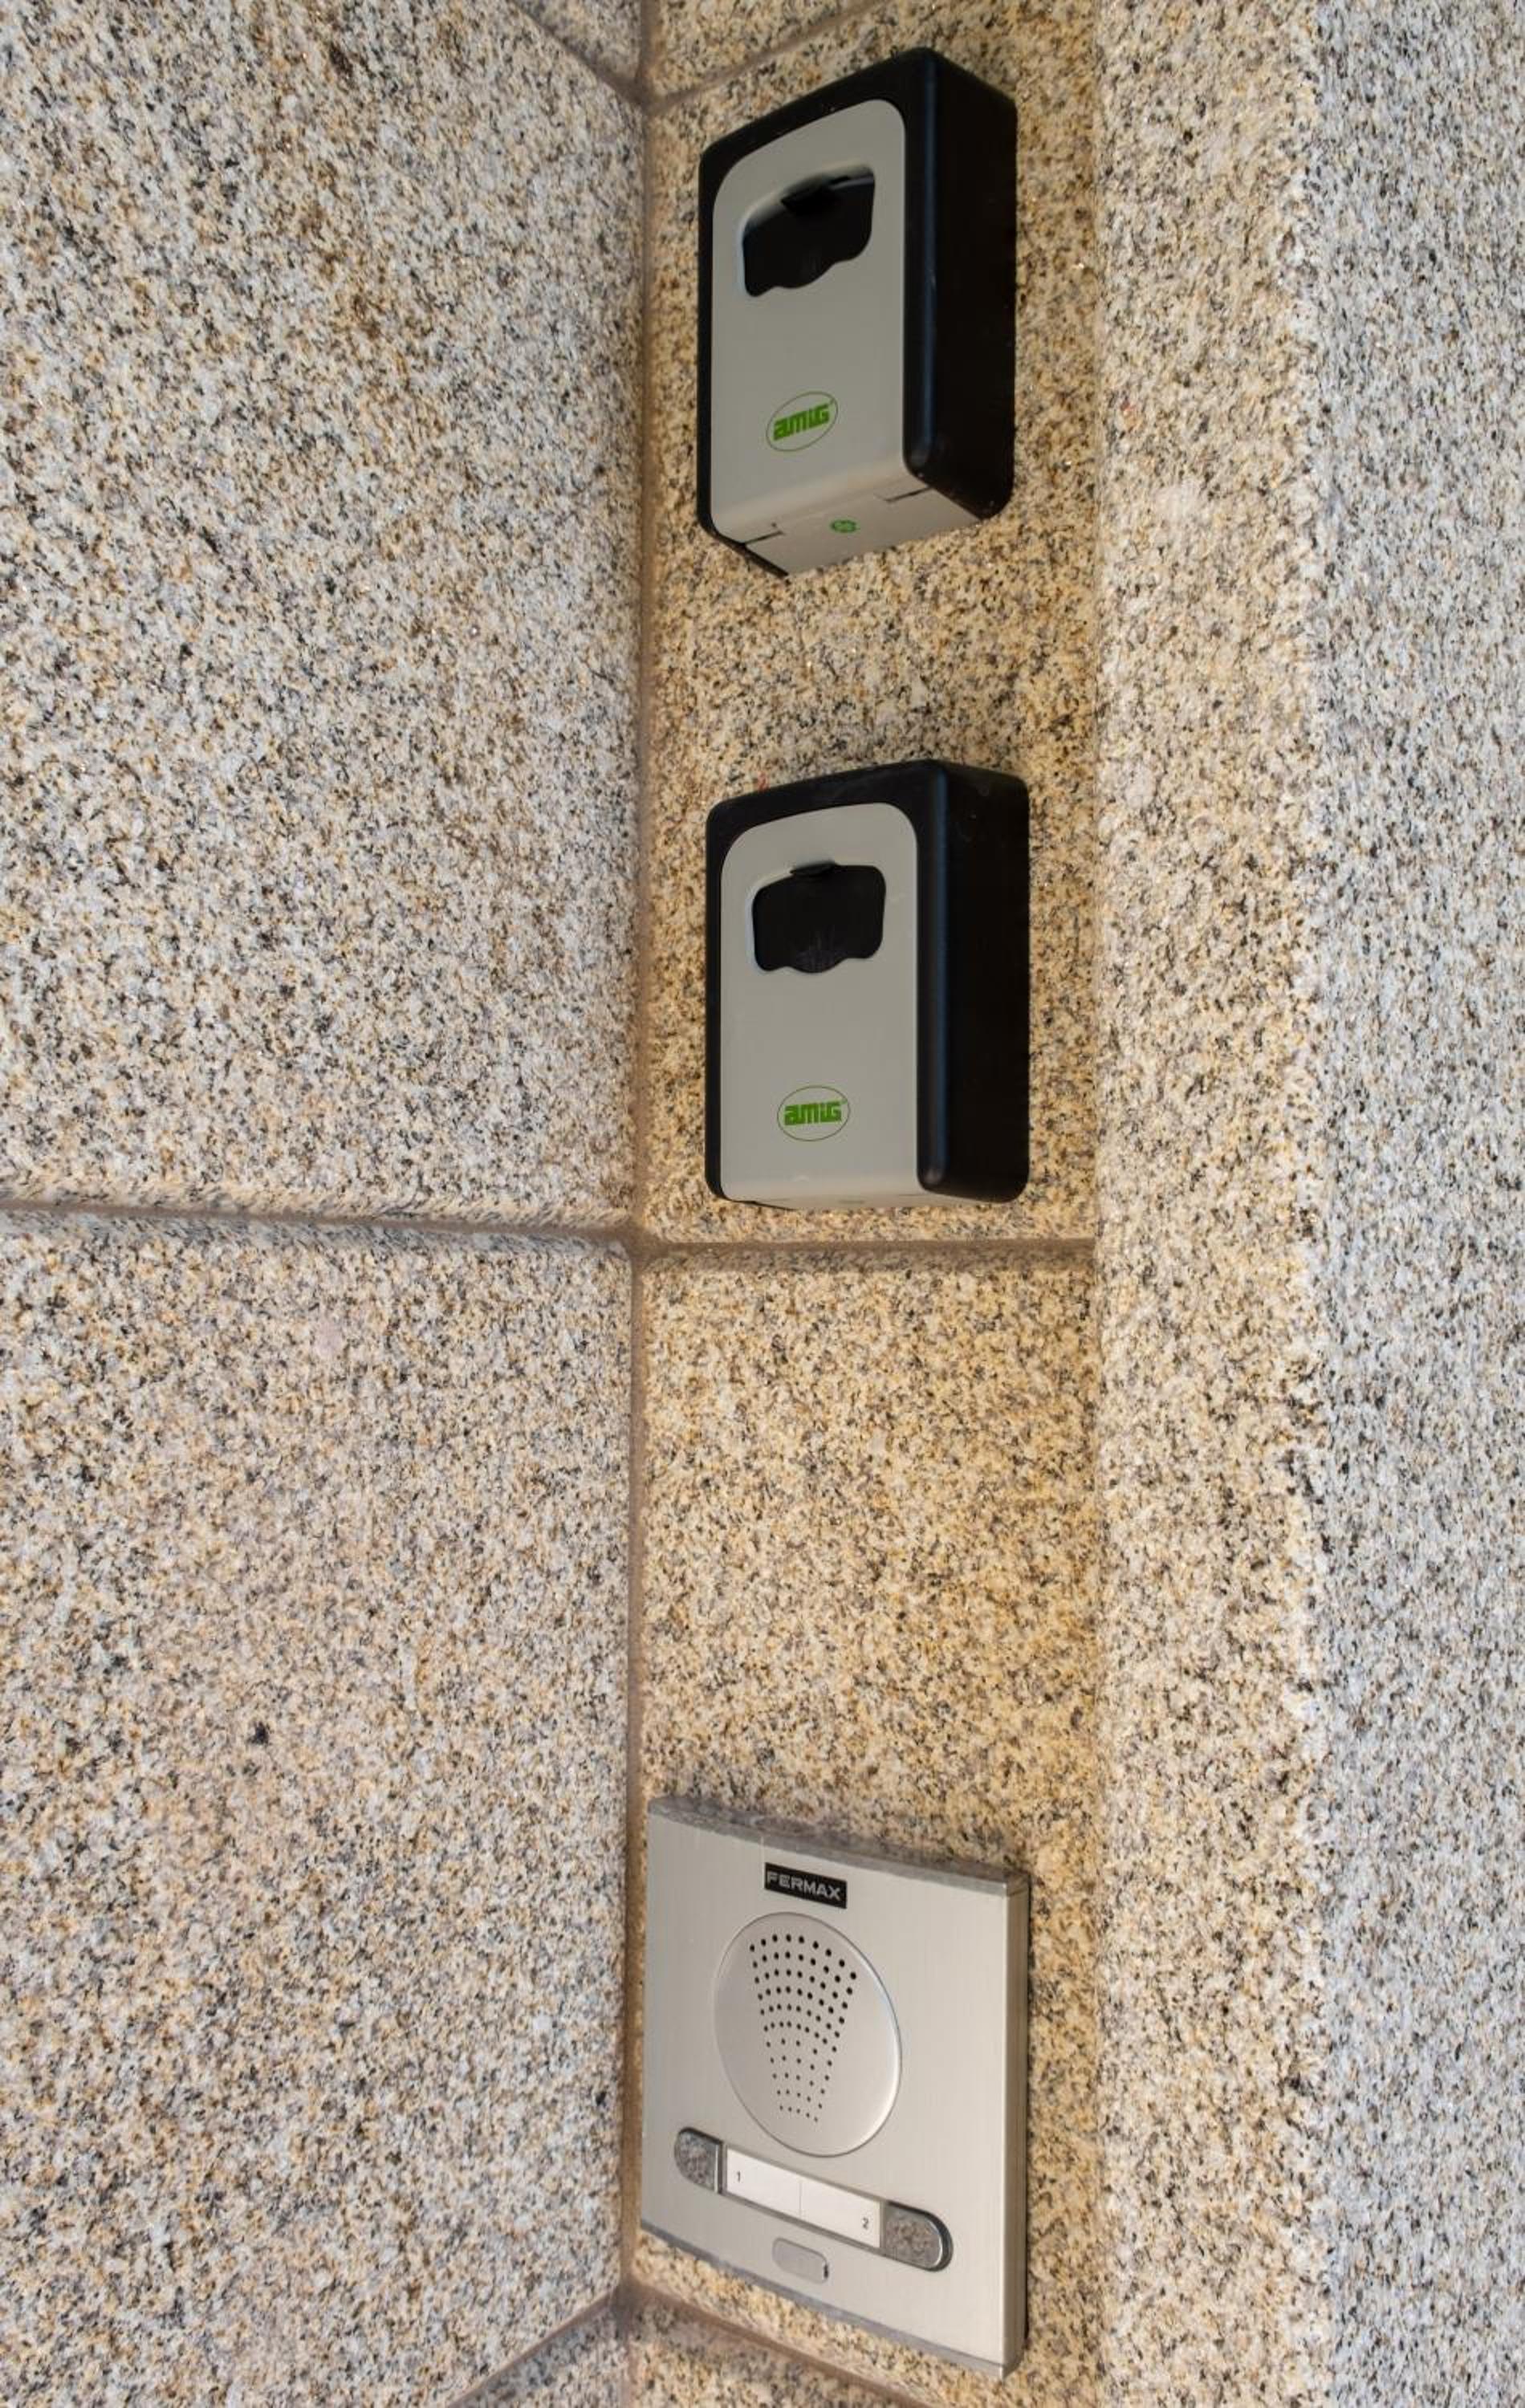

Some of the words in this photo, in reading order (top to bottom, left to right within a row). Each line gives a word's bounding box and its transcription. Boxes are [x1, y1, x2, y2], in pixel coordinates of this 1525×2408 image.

[767, 1871, 840, 1901] FERMAX
[736, 2170, 741, 2182] 1
[862, 2216, 869, 2231] 2
